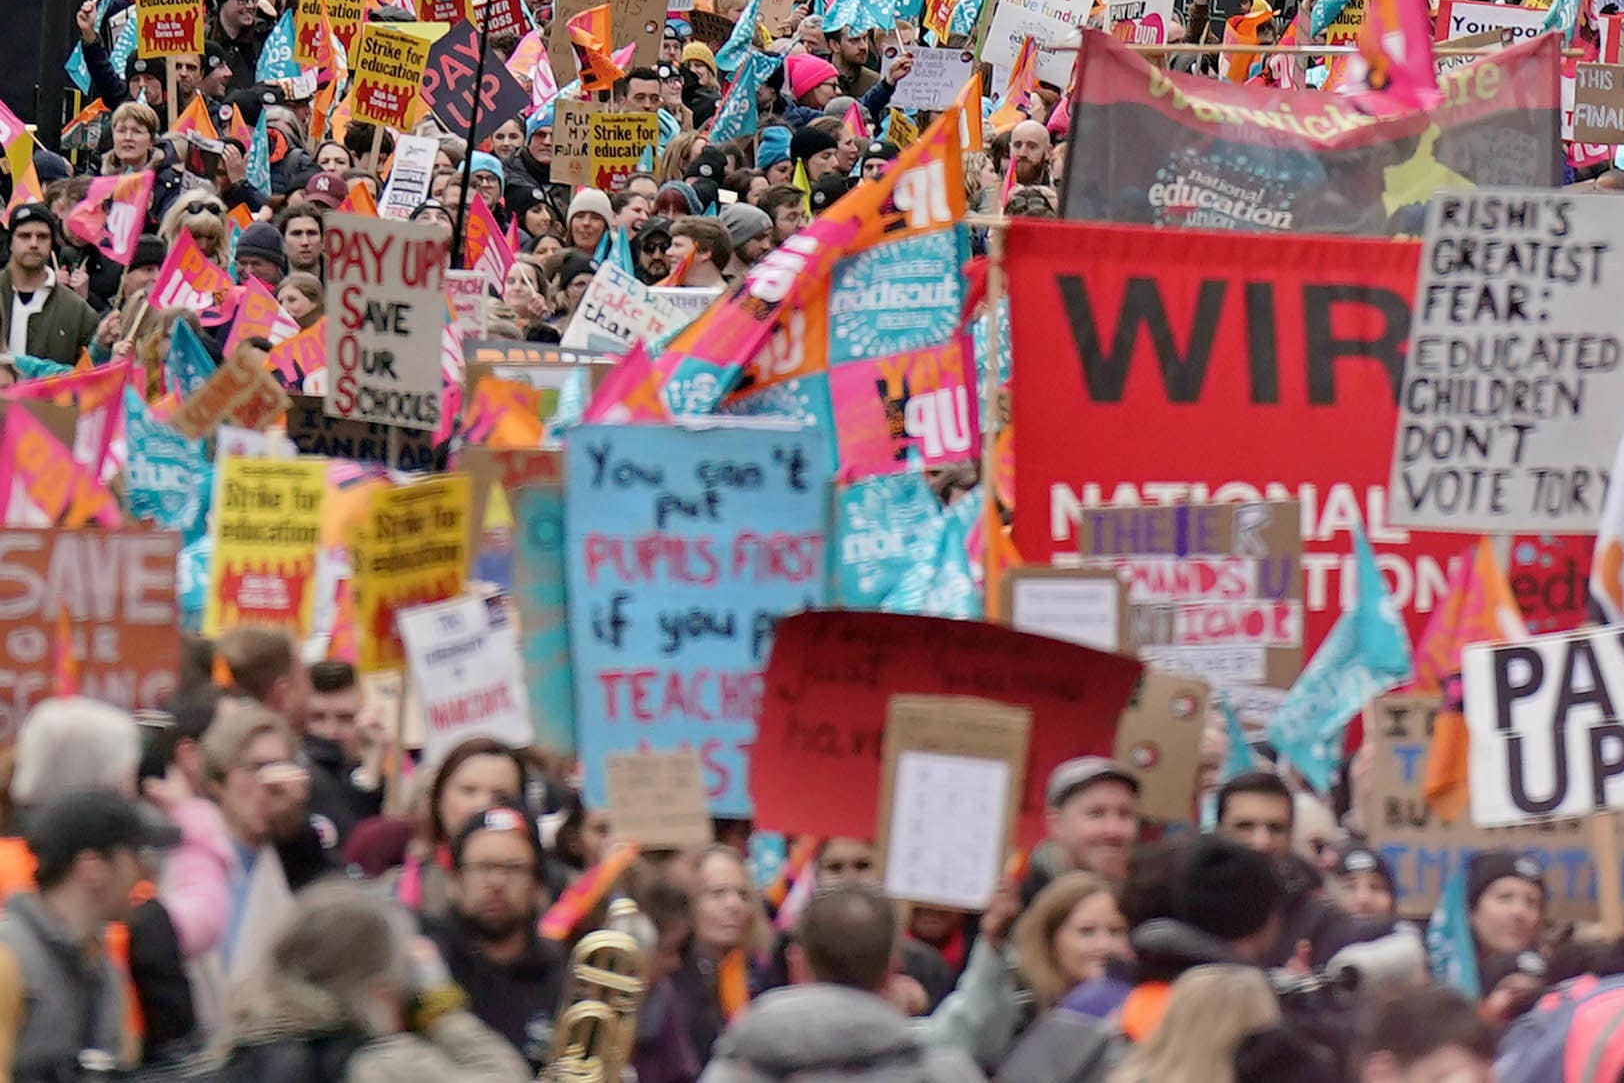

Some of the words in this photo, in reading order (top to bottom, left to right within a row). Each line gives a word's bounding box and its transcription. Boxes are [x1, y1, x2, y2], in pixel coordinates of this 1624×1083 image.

[1039, 1, 1084, 30] funds!
[360, 56, 421, 85] education
[363, 36, 401, 60] Strike
[405, 46, 425, 67] for
[420, 31, 480, 106] PAY
[447, 72, 502, 131] UP
[1577, 67, 1613, 91] THIS
[594, 121, 632, 141] Strike
[636, 122, 656, 140] for
[1147, 180, 1293, 230] education
[1187, 167, 1268, 203] national
[1443, 194, 1574, 239] RISHI'S
[326, 230, 397, 286] PAY
[1431, 237, 1605, 286] GREATEST
[340, 286, 412, 337] SAVE
[1424, 284, 1550, 322] FEAR:
[338, 335, 398, 381] OUR
[1412, 332, 1624, 374] EDUCATED
[334, 376, 441, 424] SCHOOLS
[1404, 377, 1586, 420] CHILDREN
[1402, 421, 1535, 465] DON'T
[586, 444, 663, 491] You
[694, 444, 812, 491] can't
[222, 480, 290, 512] Strike
[293, 480, 324, 513] for
[652, 490, 722, 529] put
[1402, 470, 1508, 516] VOTE
[220, 521, 321, 547] education
[0, 532, 178, 625] SAVE
[582, 530, 721, 588] PUPILS
[731, 530, 824, 584] FIRST
[592, 591, 632, 650] if
[658, 611, 736, 654] you
